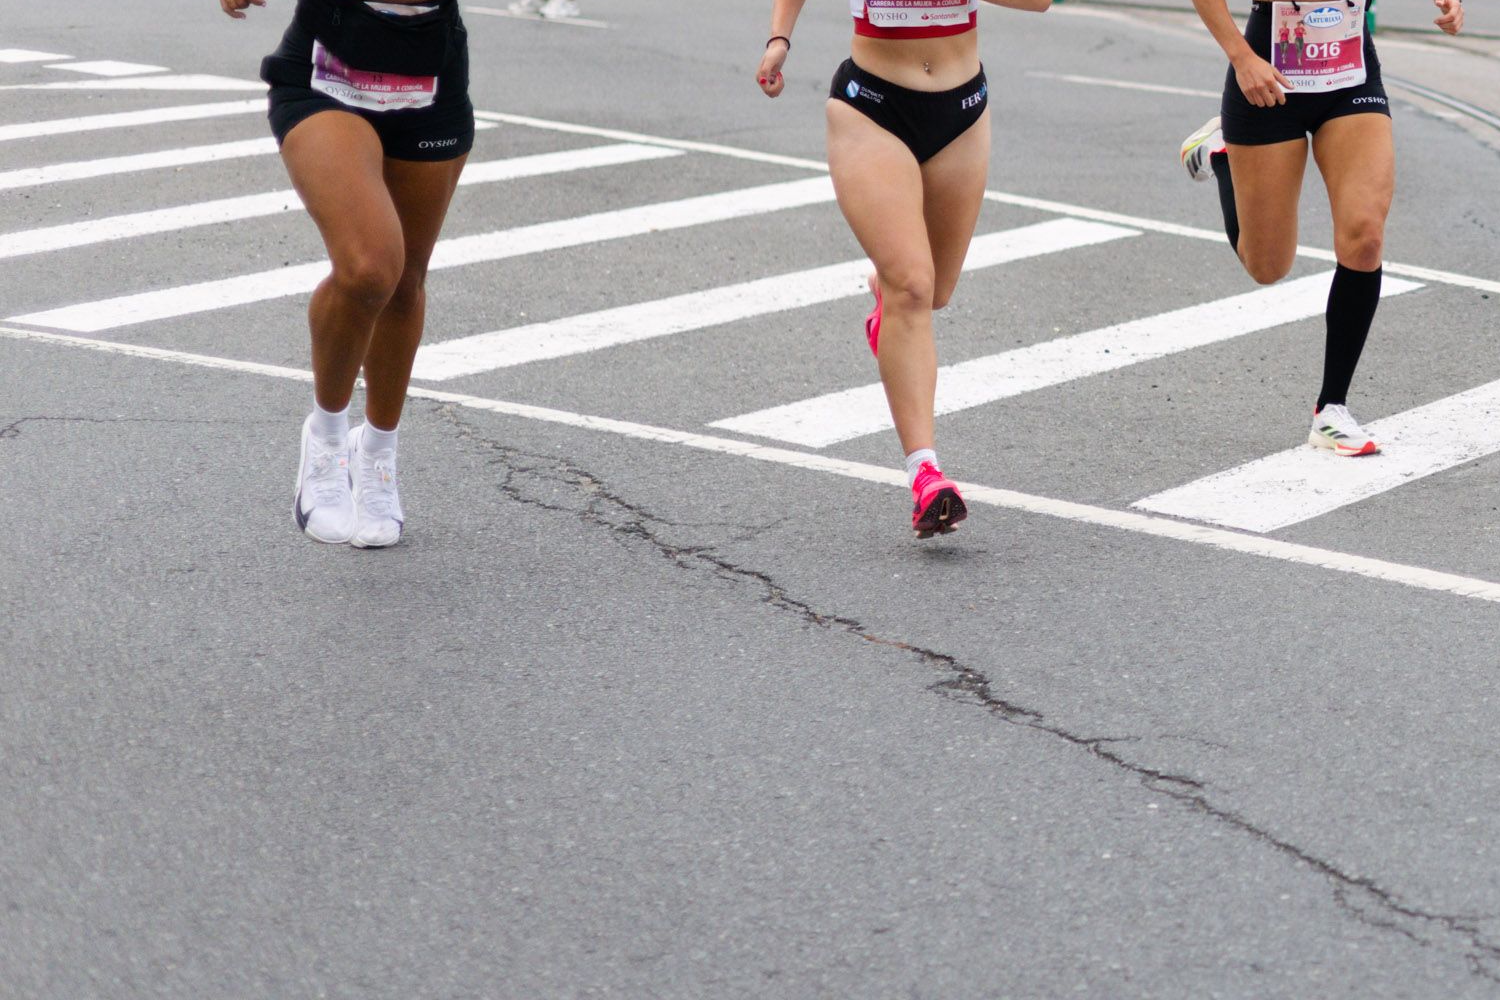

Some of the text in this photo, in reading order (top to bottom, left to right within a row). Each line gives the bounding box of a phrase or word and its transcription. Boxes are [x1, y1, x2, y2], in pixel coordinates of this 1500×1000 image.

[873, 12, 908, 21] OYSHO
[930, 12, 960, 20] Santander
[1305, 42, 1340, 58] 016
[1321, 60, 1328, 68] 17
[1289, 79, 1316, 87] YSHO
[325, 86, 364, 101] OYSHO
[1352, 96, 1386, 105] OYSHO
[418, 138, 458, 149] OYSHO
